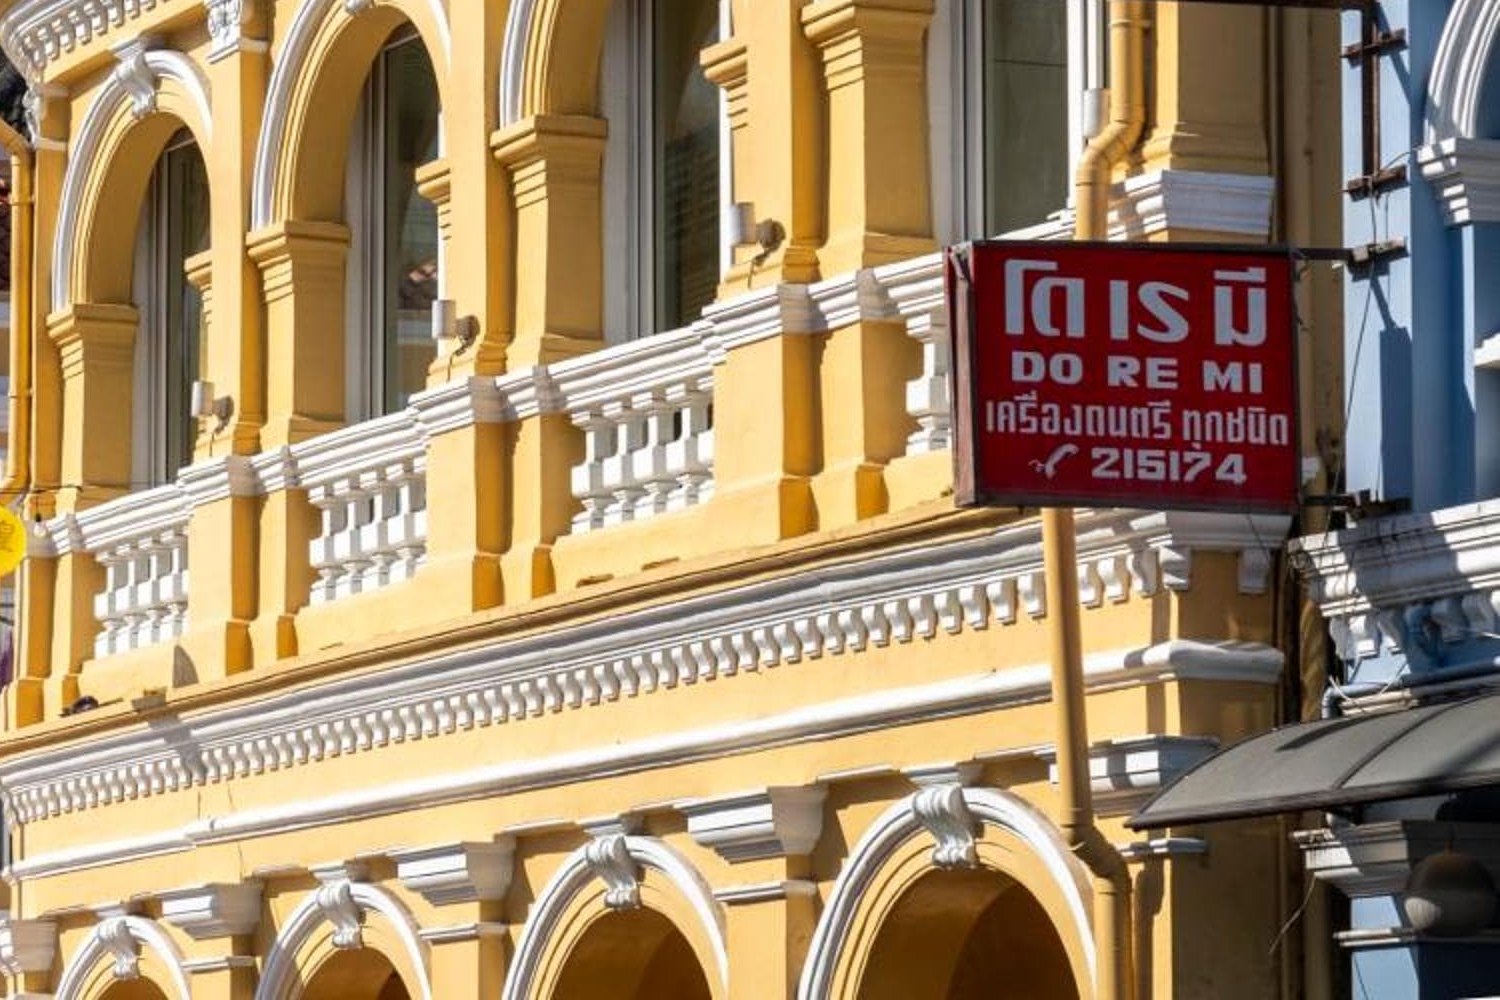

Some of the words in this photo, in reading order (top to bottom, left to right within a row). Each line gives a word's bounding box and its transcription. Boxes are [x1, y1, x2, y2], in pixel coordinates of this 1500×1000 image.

[1004, 258, 1085, 338] โด
[1109, 279, 1190, 343] เร
[1213, 266, 1268, 347] มี
[1011, 351, 1083, 385] DO
[1107, 355, 1179, 390] RE
[1203, 361, 1263, 394] MI
[1091, 447, 1247, 484] 215174
